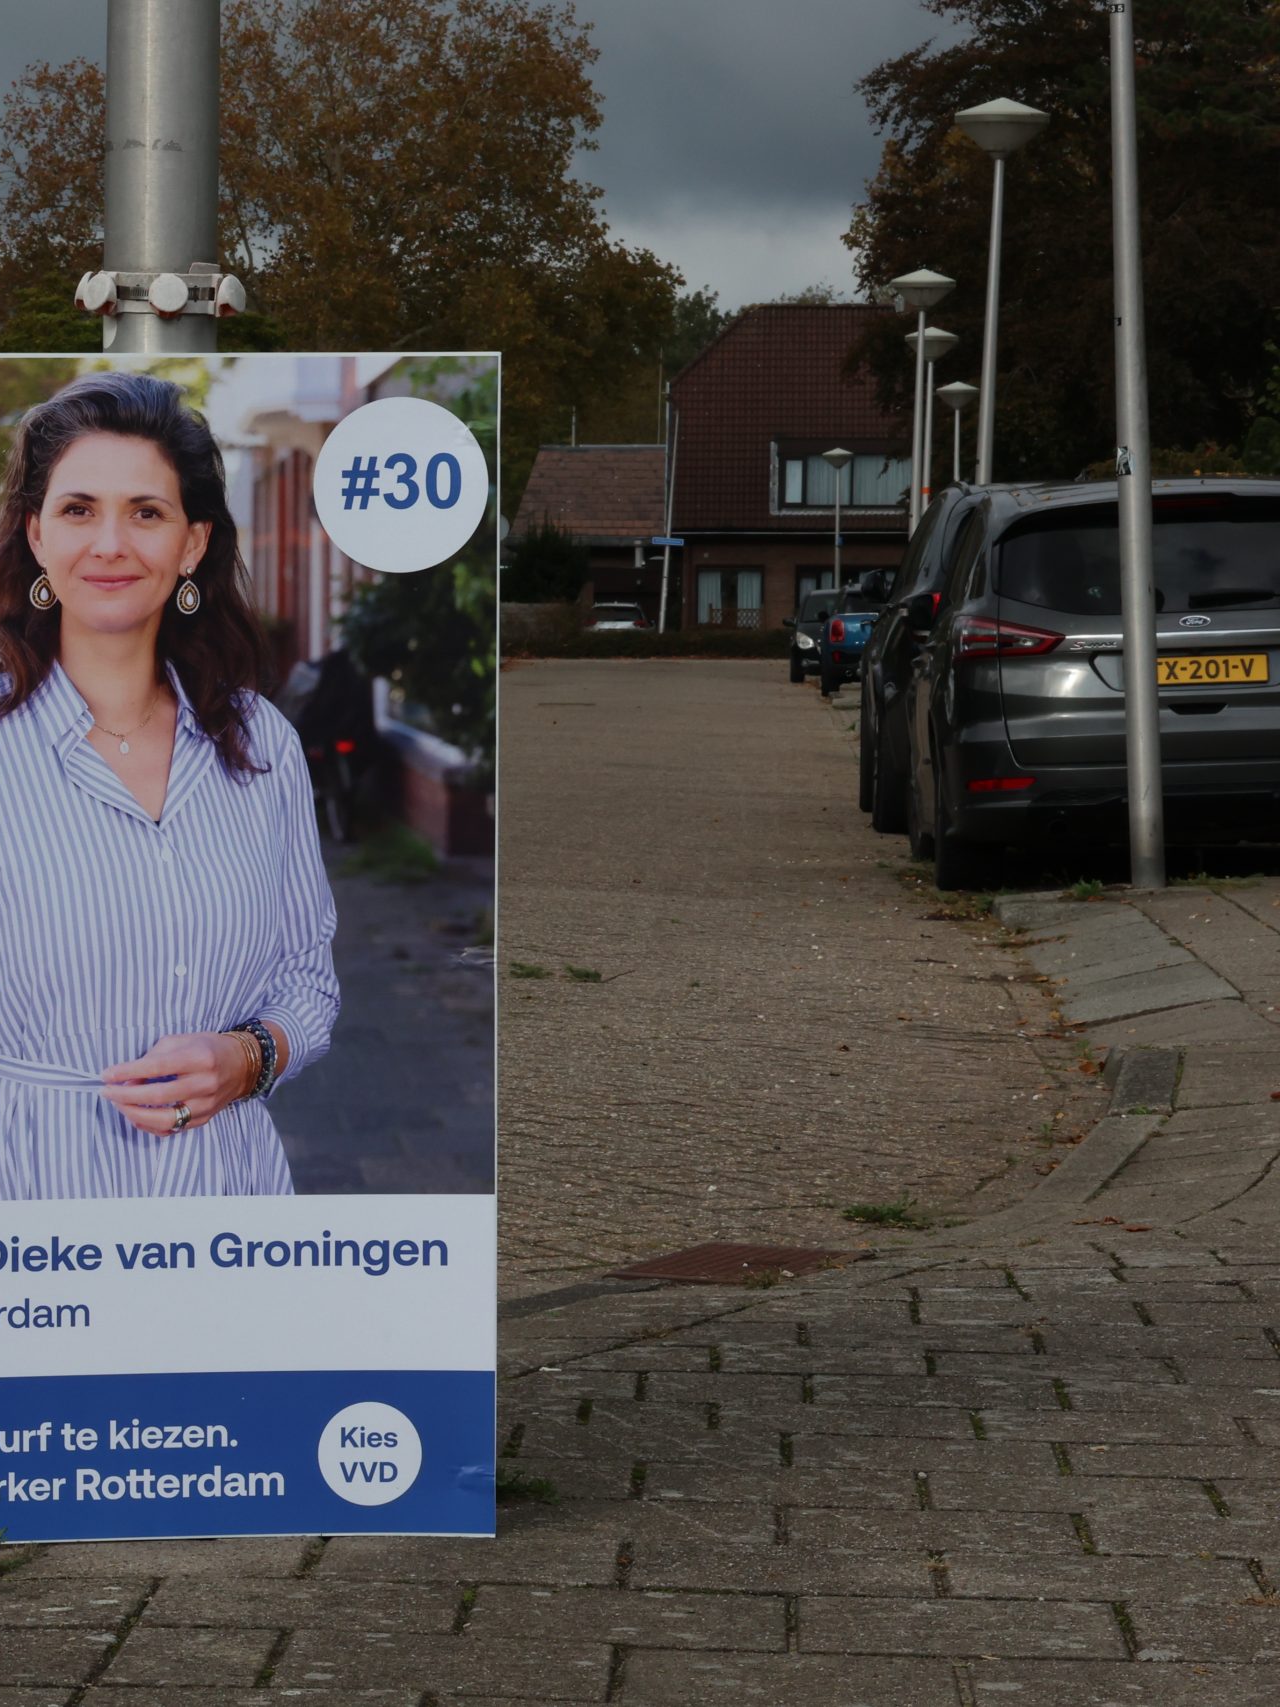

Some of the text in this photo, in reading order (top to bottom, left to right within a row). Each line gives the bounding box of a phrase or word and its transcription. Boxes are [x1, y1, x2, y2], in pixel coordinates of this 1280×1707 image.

[342, 453, 462, 510] #30
[115, 1242, 195, 1270] van
[210, 1230, 448, 1276] Groningen
[61, 1422, 98, 1451] te
[109, 1418, 238, 1450] kiezen.
[340, 1426, 398, 1448] Kies
[76, 1465, 285, 1501] Rotterdam
[339, 1461, 398, 1483] VVD
